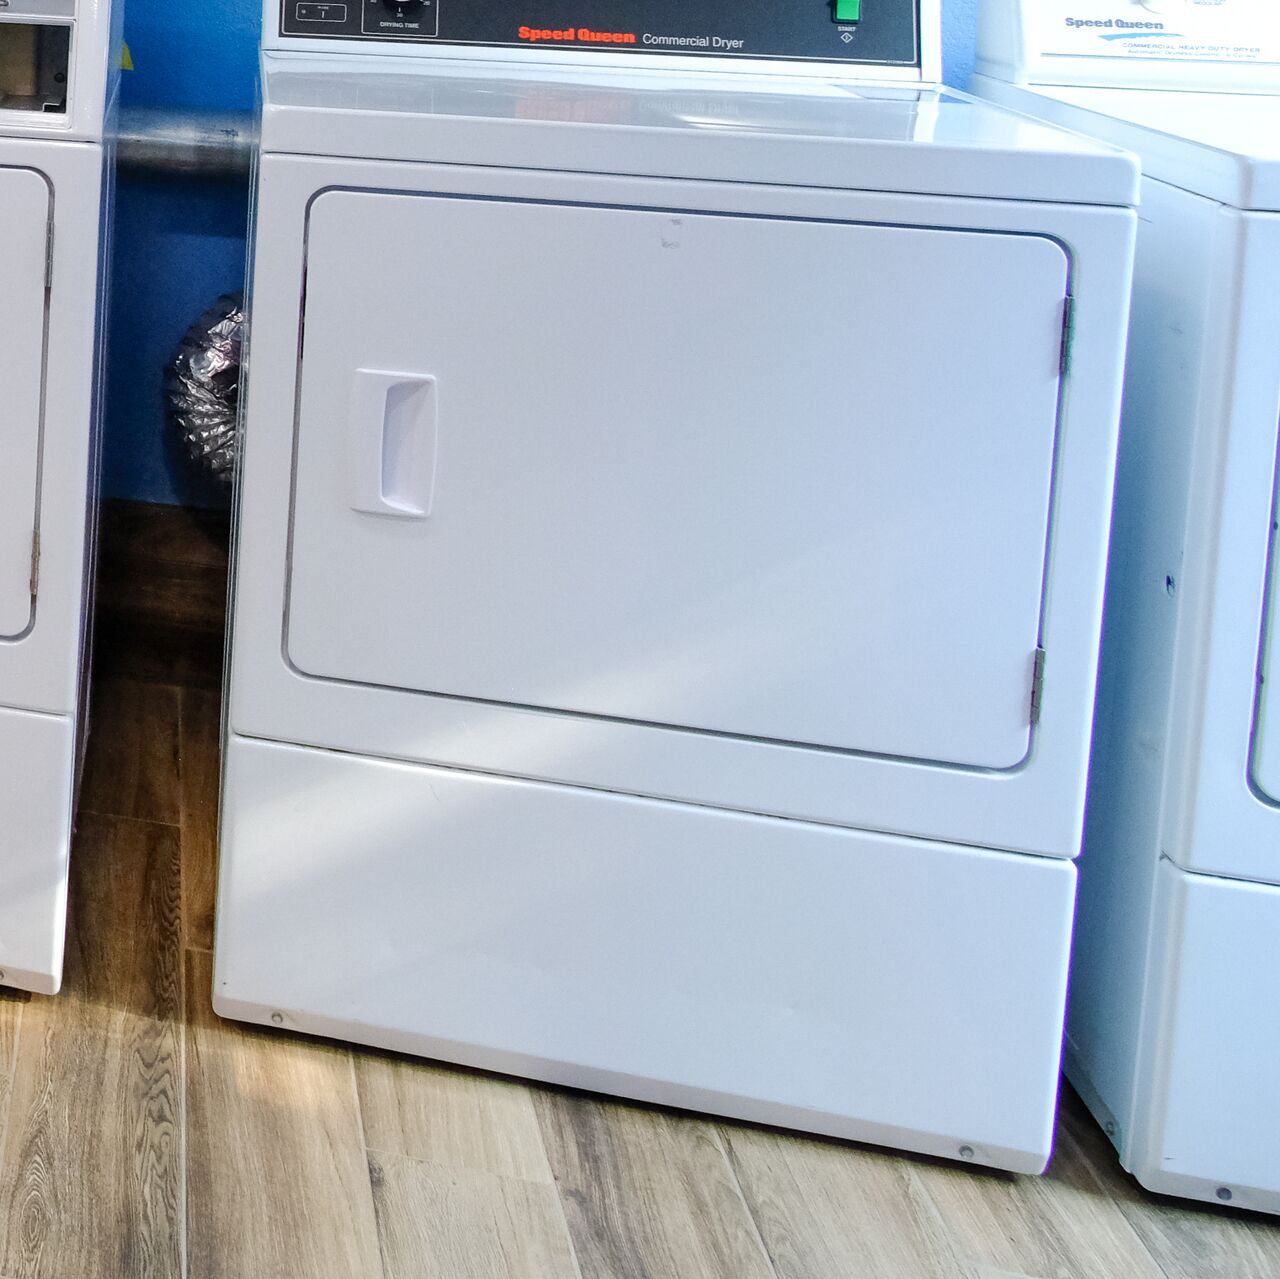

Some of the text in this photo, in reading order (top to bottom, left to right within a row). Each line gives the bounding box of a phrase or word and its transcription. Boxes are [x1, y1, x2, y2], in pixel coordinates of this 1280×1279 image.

[1065, 17, 1164, 30] Speed Queen
[518, 26, 744, 50] Speed Queen Commercial Dryer
[1122, 42, 1175, 50] COMMERCIAL
